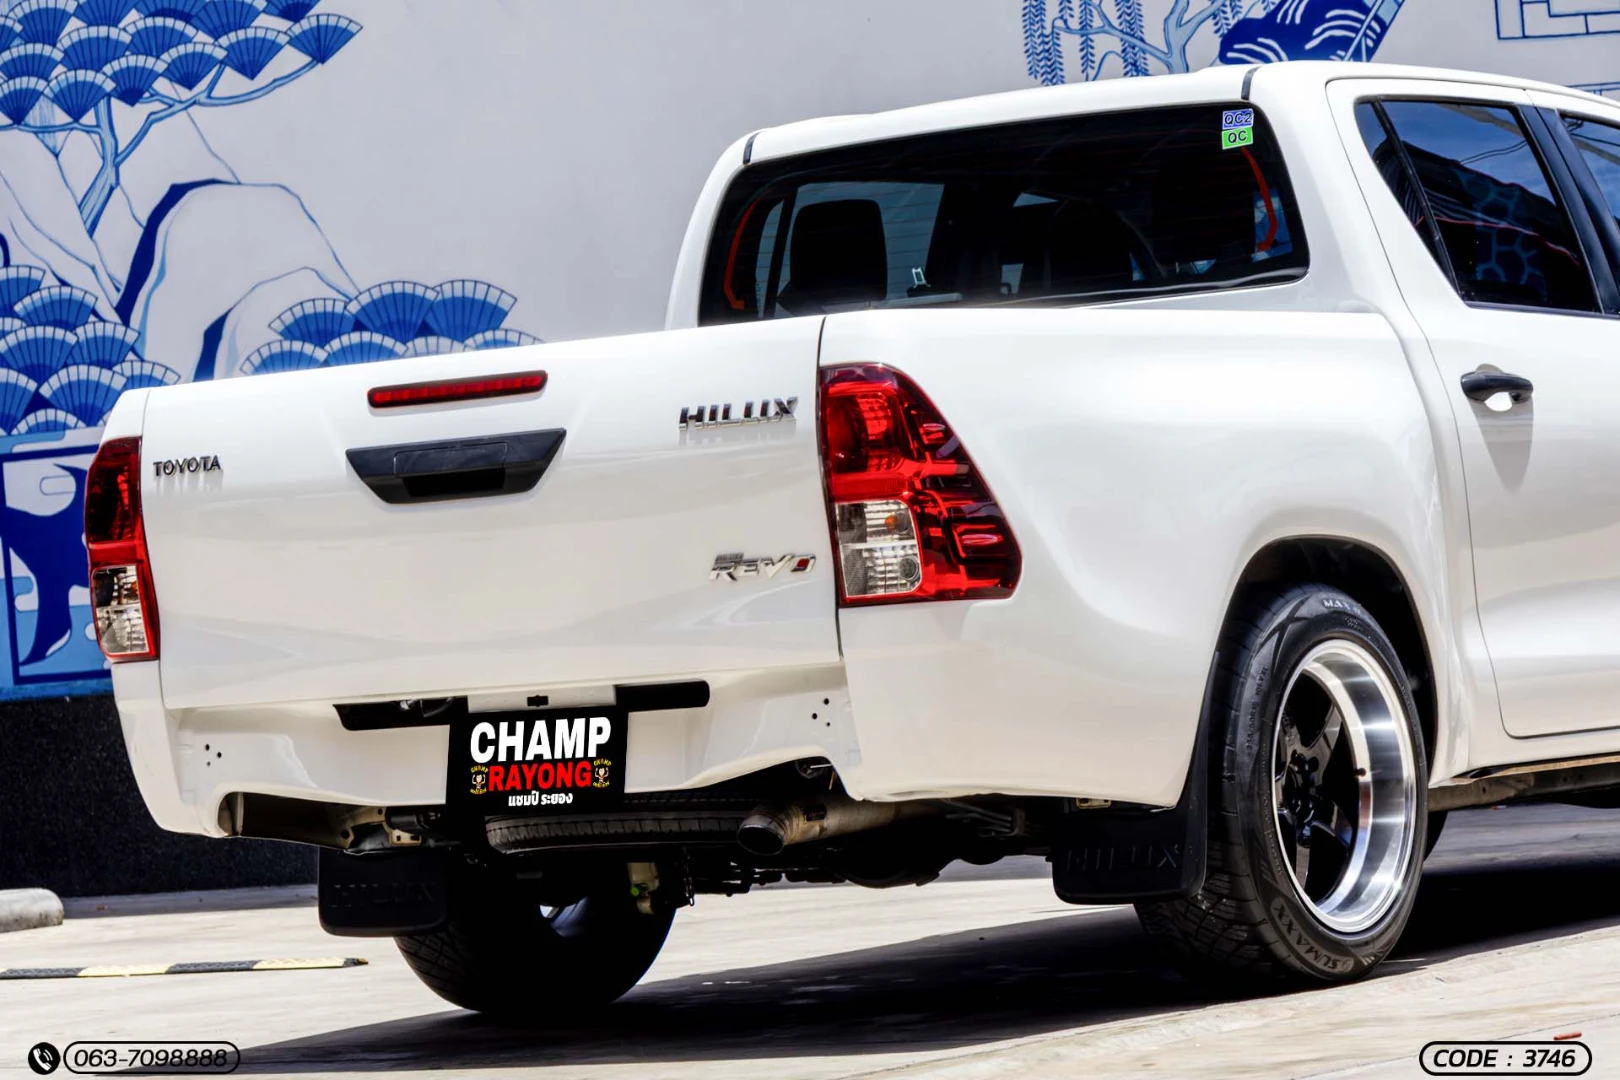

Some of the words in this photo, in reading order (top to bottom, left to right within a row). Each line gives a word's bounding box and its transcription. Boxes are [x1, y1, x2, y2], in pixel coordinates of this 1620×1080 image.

[1225, 112, 1252, 125] QC2
[1228, 130, 1247, 143] QC
[679, 396, 798, 431] HILUX
[153, 455, 222, 476] TOYOTA
[708, 552, 817, 581] REVO
[470, 716, 612, 764] CHAMP
[488, 760, 593, 792] RAYONG
